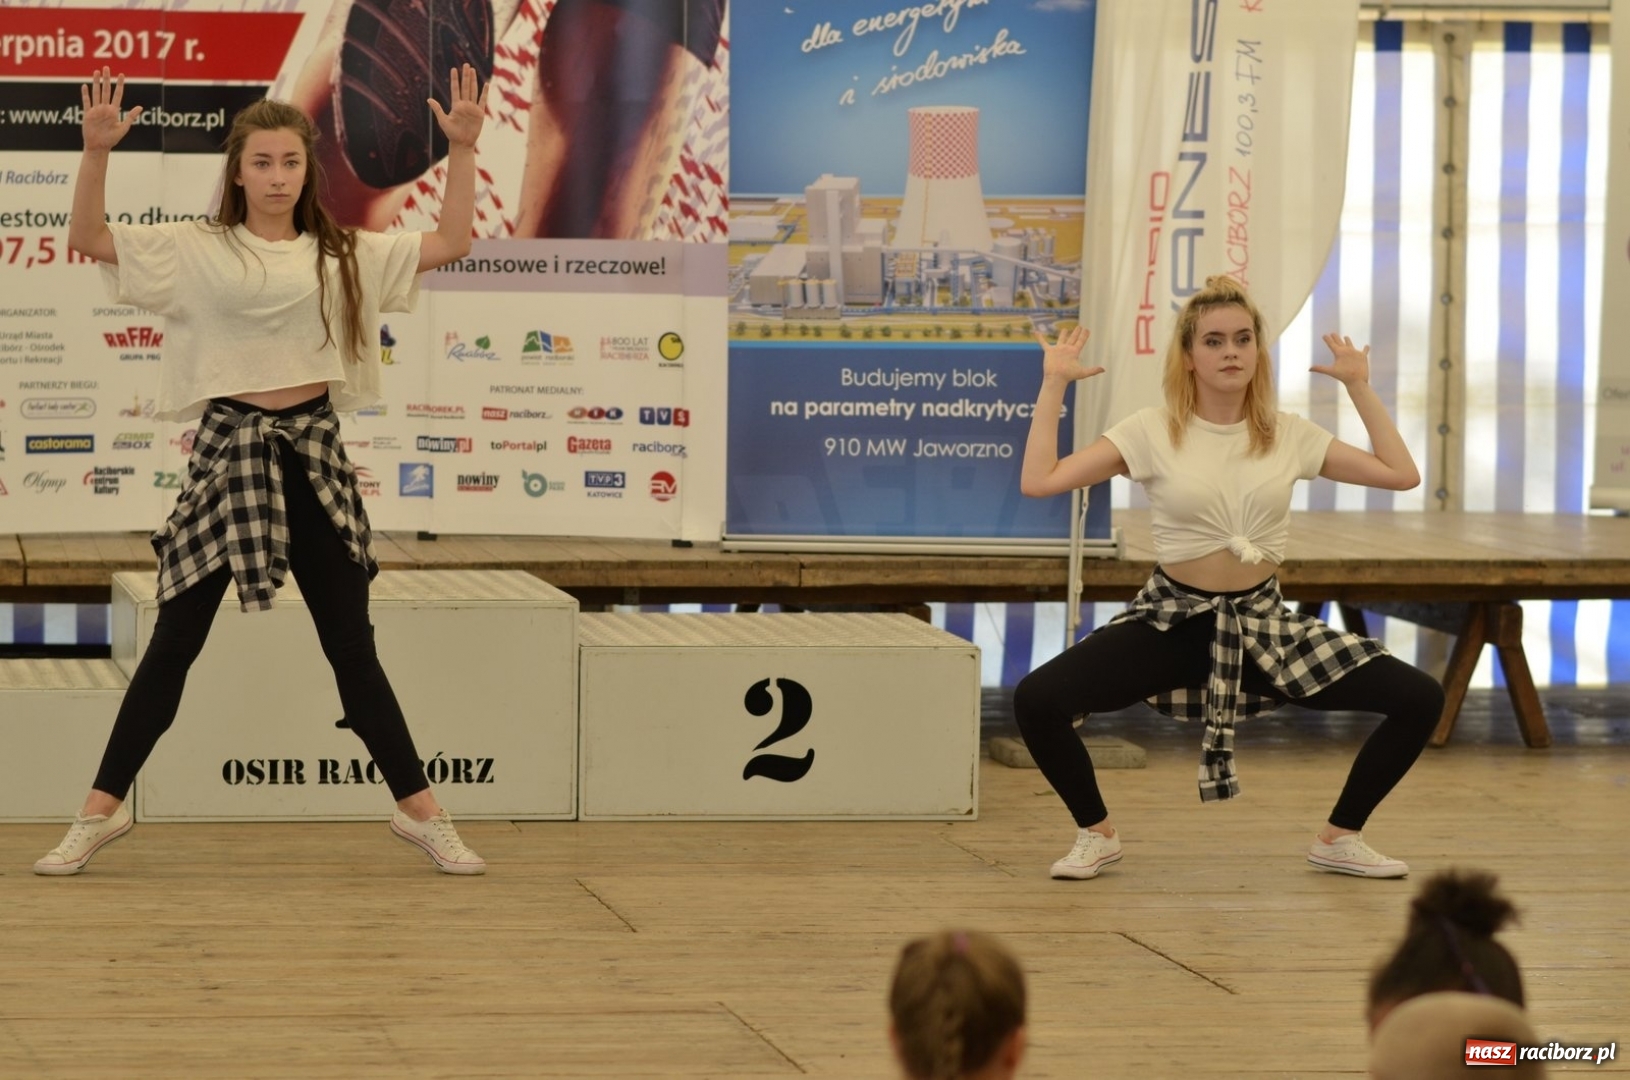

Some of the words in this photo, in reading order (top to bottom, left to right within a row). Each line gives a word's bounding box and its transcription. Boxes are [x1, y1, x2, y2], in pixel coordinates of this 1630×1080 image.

[0, 28, 84, 65] rpnia
[93, 30, 176, 60] 2017
[184, 38, 205, 62] r.
[801, 21, 844, 53] dla
[1235, 39, 1264, 85] FM
[5, 171, 69, 185] Racibórz
[553, 255, 559, 273] i
[565, 257, 666, 275] rzeczowe!
[19, 381, 68, 390] PARTNERZY
[841, 367, 946, 390] Budujemy
[953, 368, 998, 387] blok
[489, 385, 535, 395] PATRONAT
[771, 402, 798, 416] na
[804, 398, 916, 420] parametry
[28, 439, 91, 450] castorama
[567, 436, 612, 454] Gazeta
[824, 438, 861, 457] 910
[867, 439, 906, 456] MW
[913, 439, 1013, 457] Jaworzno
[458, 472, 500, 488] nowiny
[743, 678, 815, 783] 2
[222, 758, 307, 785] OSIR
